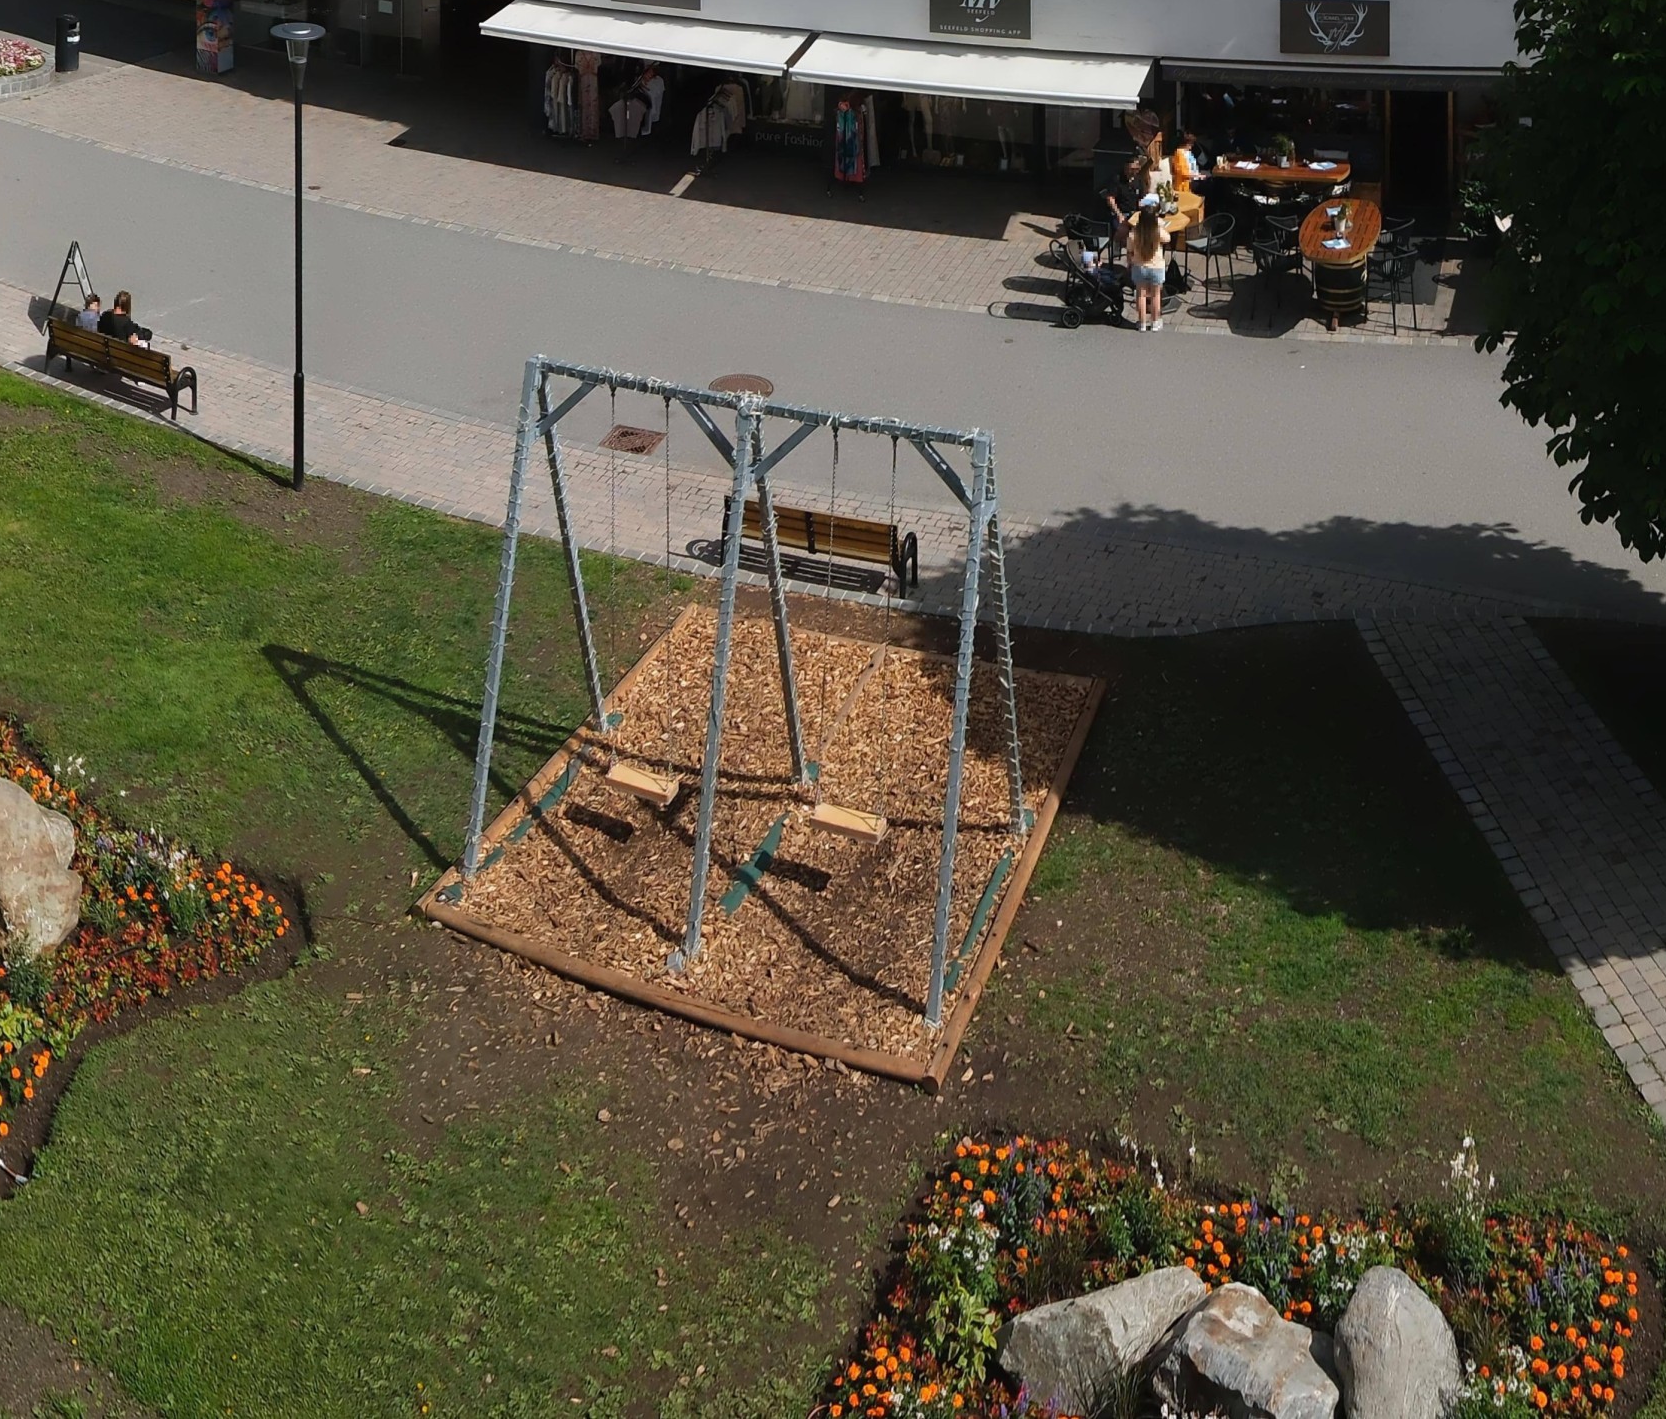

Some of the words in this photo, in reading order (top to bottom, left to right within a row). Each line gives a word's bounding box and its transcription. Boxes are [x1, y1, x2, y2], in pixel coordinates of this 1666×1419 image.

[967, 8, 995, 16] SEEFELD
[939, 24, 969, 32] SEEFELD
[971, 26, 1006, 35] SHOPPING
